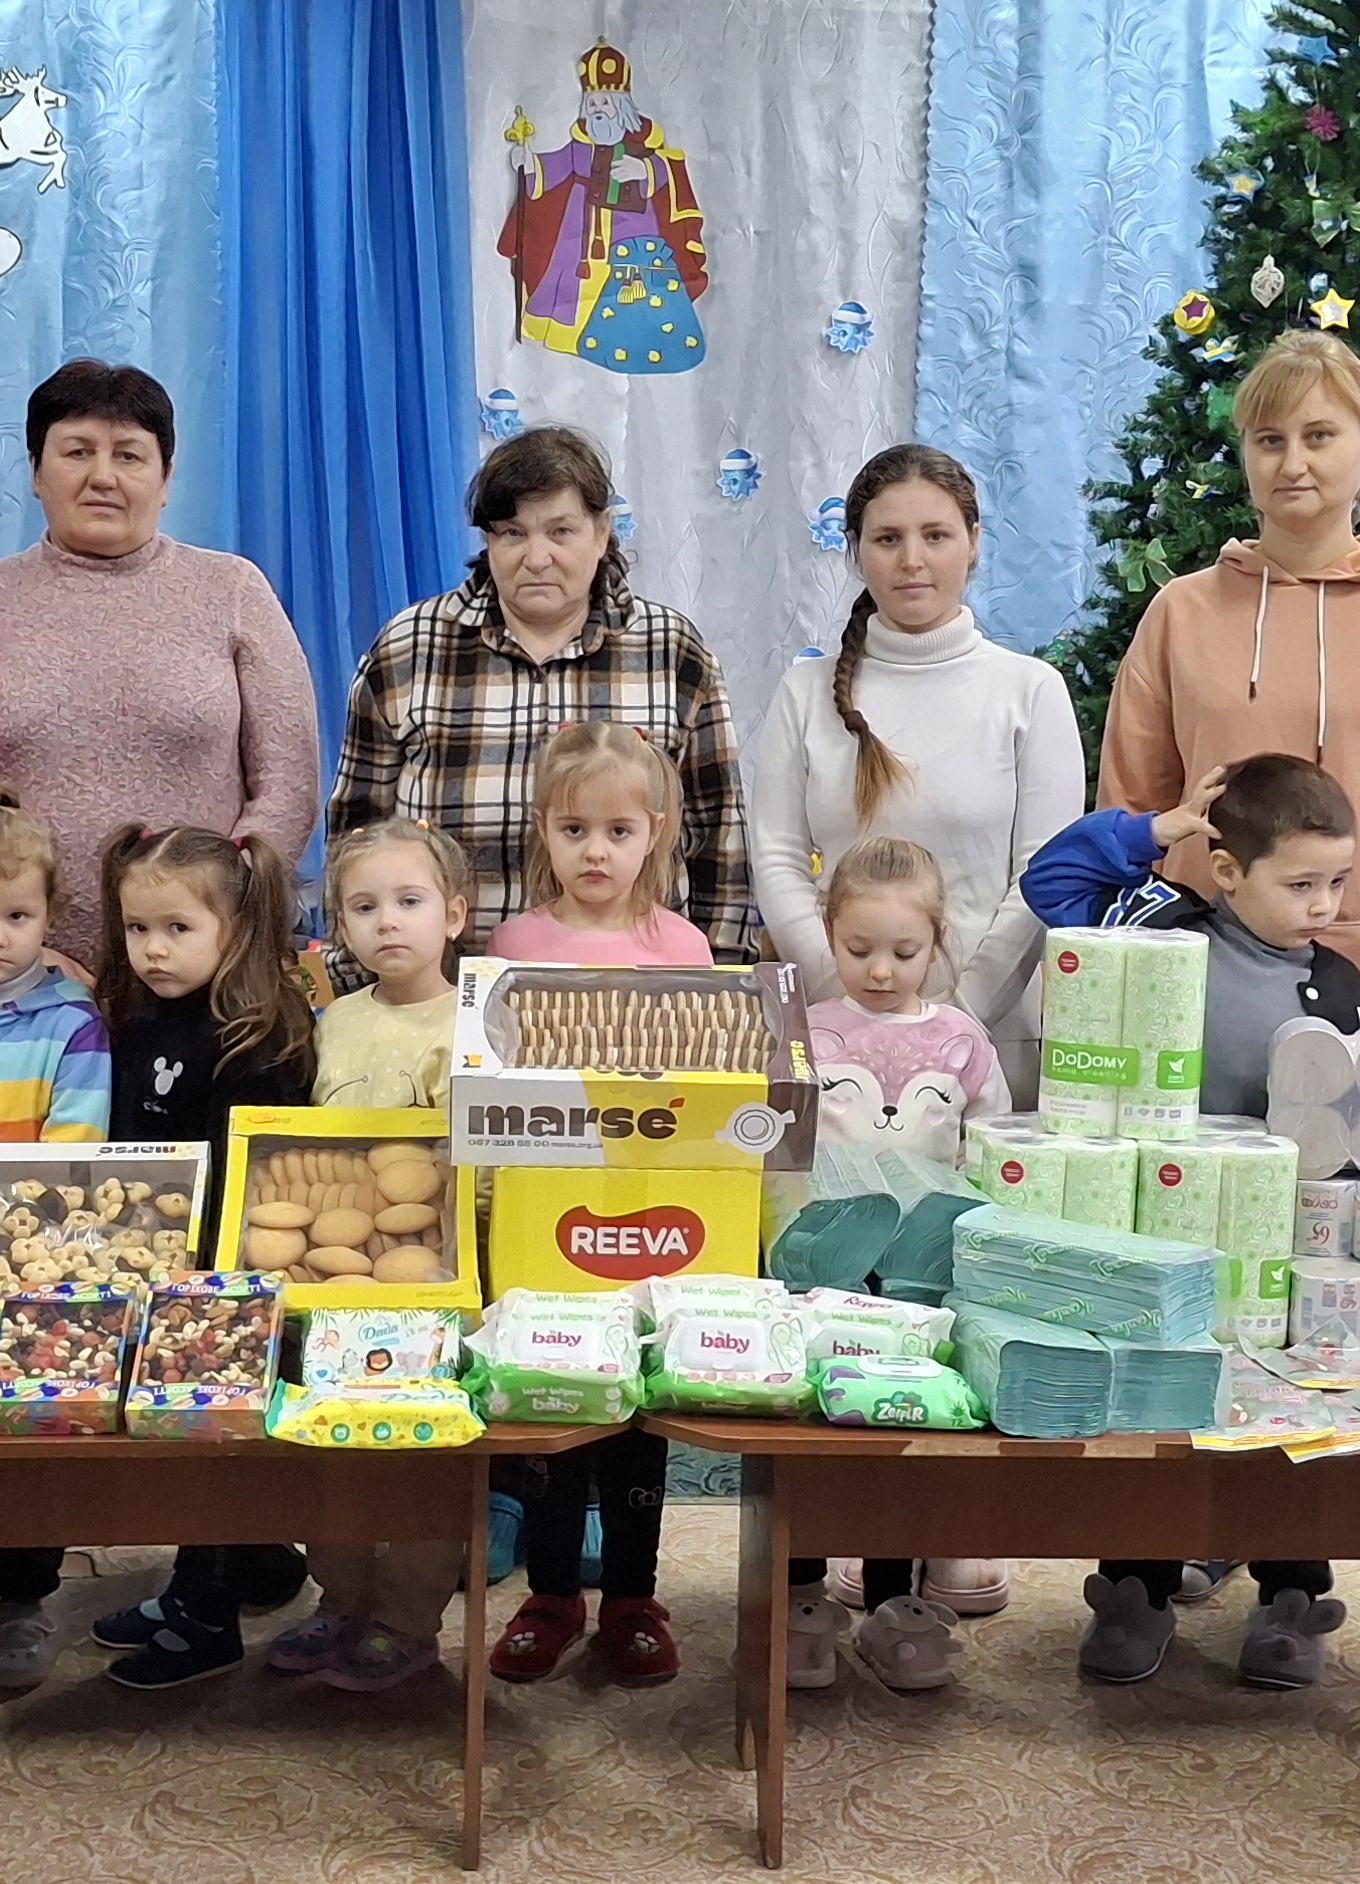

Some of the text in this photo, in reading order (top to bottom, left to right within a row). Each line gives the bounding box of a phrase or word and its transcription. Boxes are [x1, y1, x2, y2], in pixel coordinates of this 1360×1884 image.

[570, 1225, 689, 1256] REEVA
[532, 1331, 583, 1347] baby
[700, 1331, 751, 1354] baby
